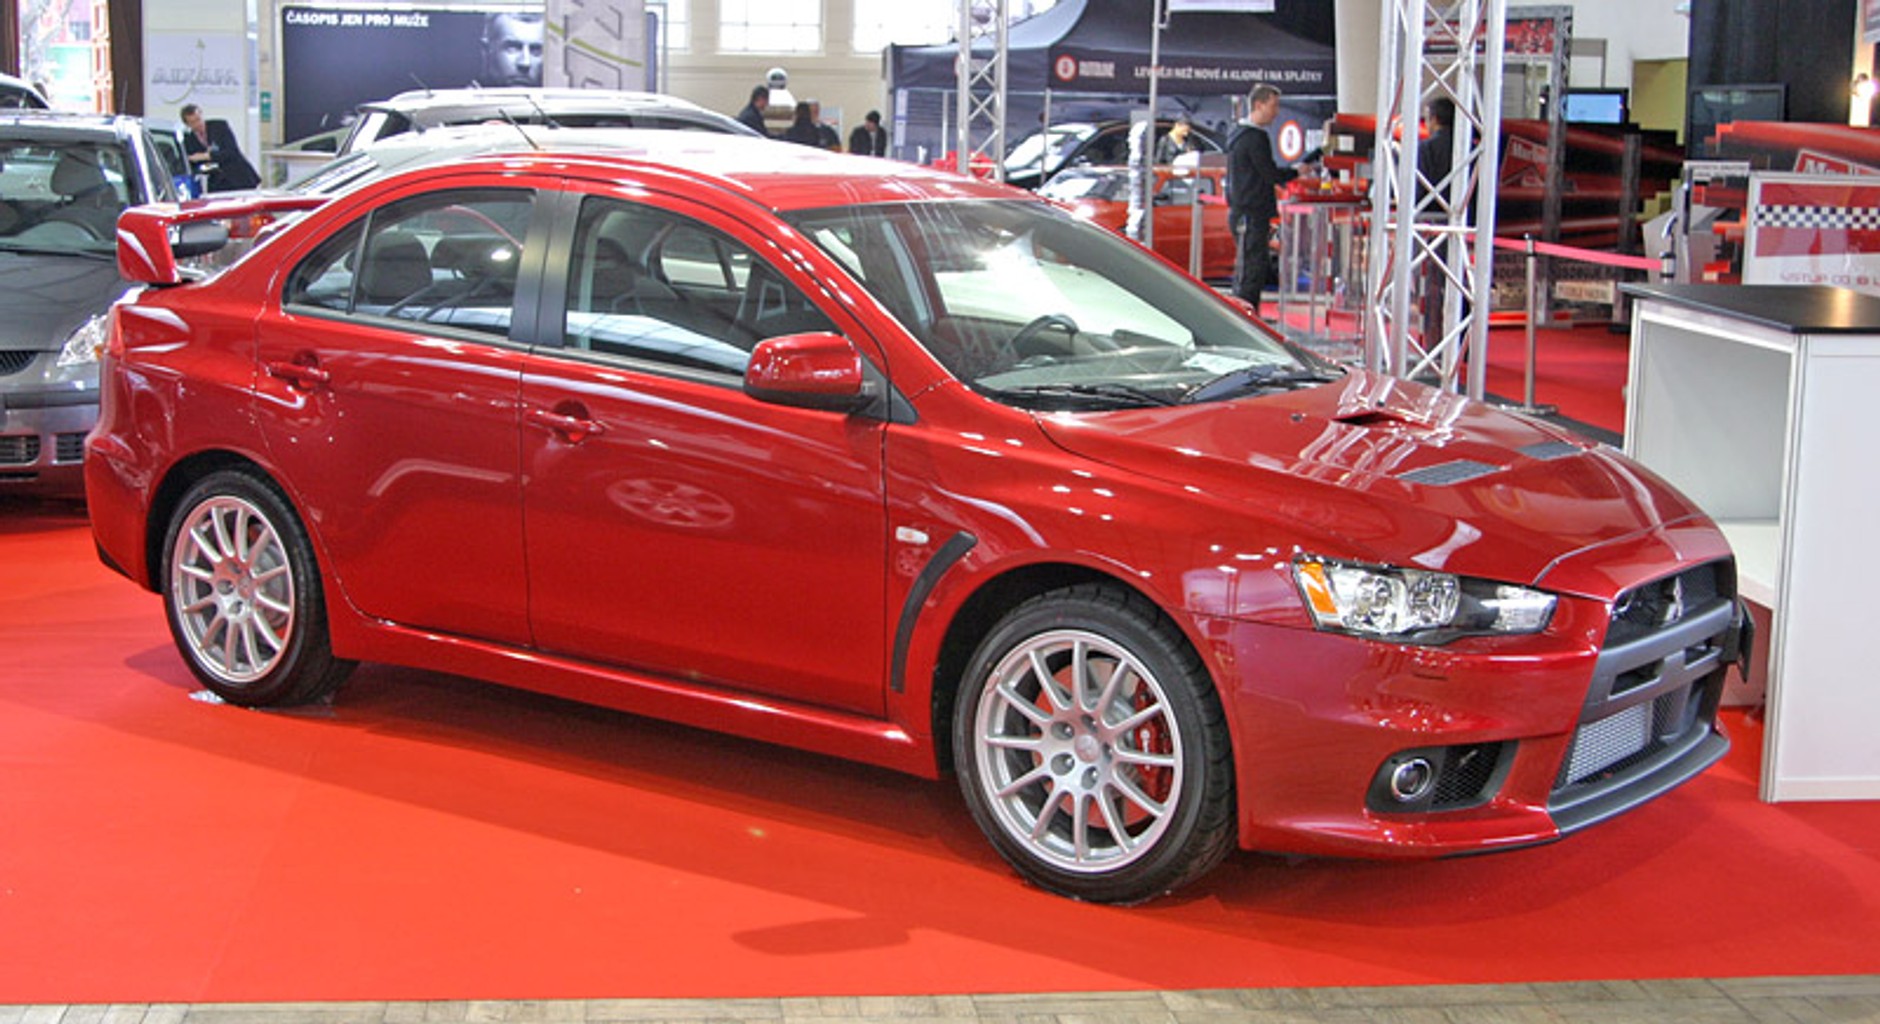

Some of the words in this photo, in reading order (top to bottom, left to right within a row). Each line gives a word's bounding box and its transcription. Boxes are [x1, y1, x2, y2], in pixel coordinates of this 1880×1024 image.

[286, 10, 339, 25] ČASOPIS
[341, 14, 363, 26] JEN
[365, 14, 391, 26] PRO
[393, 13, 429, 27] MUŽE
